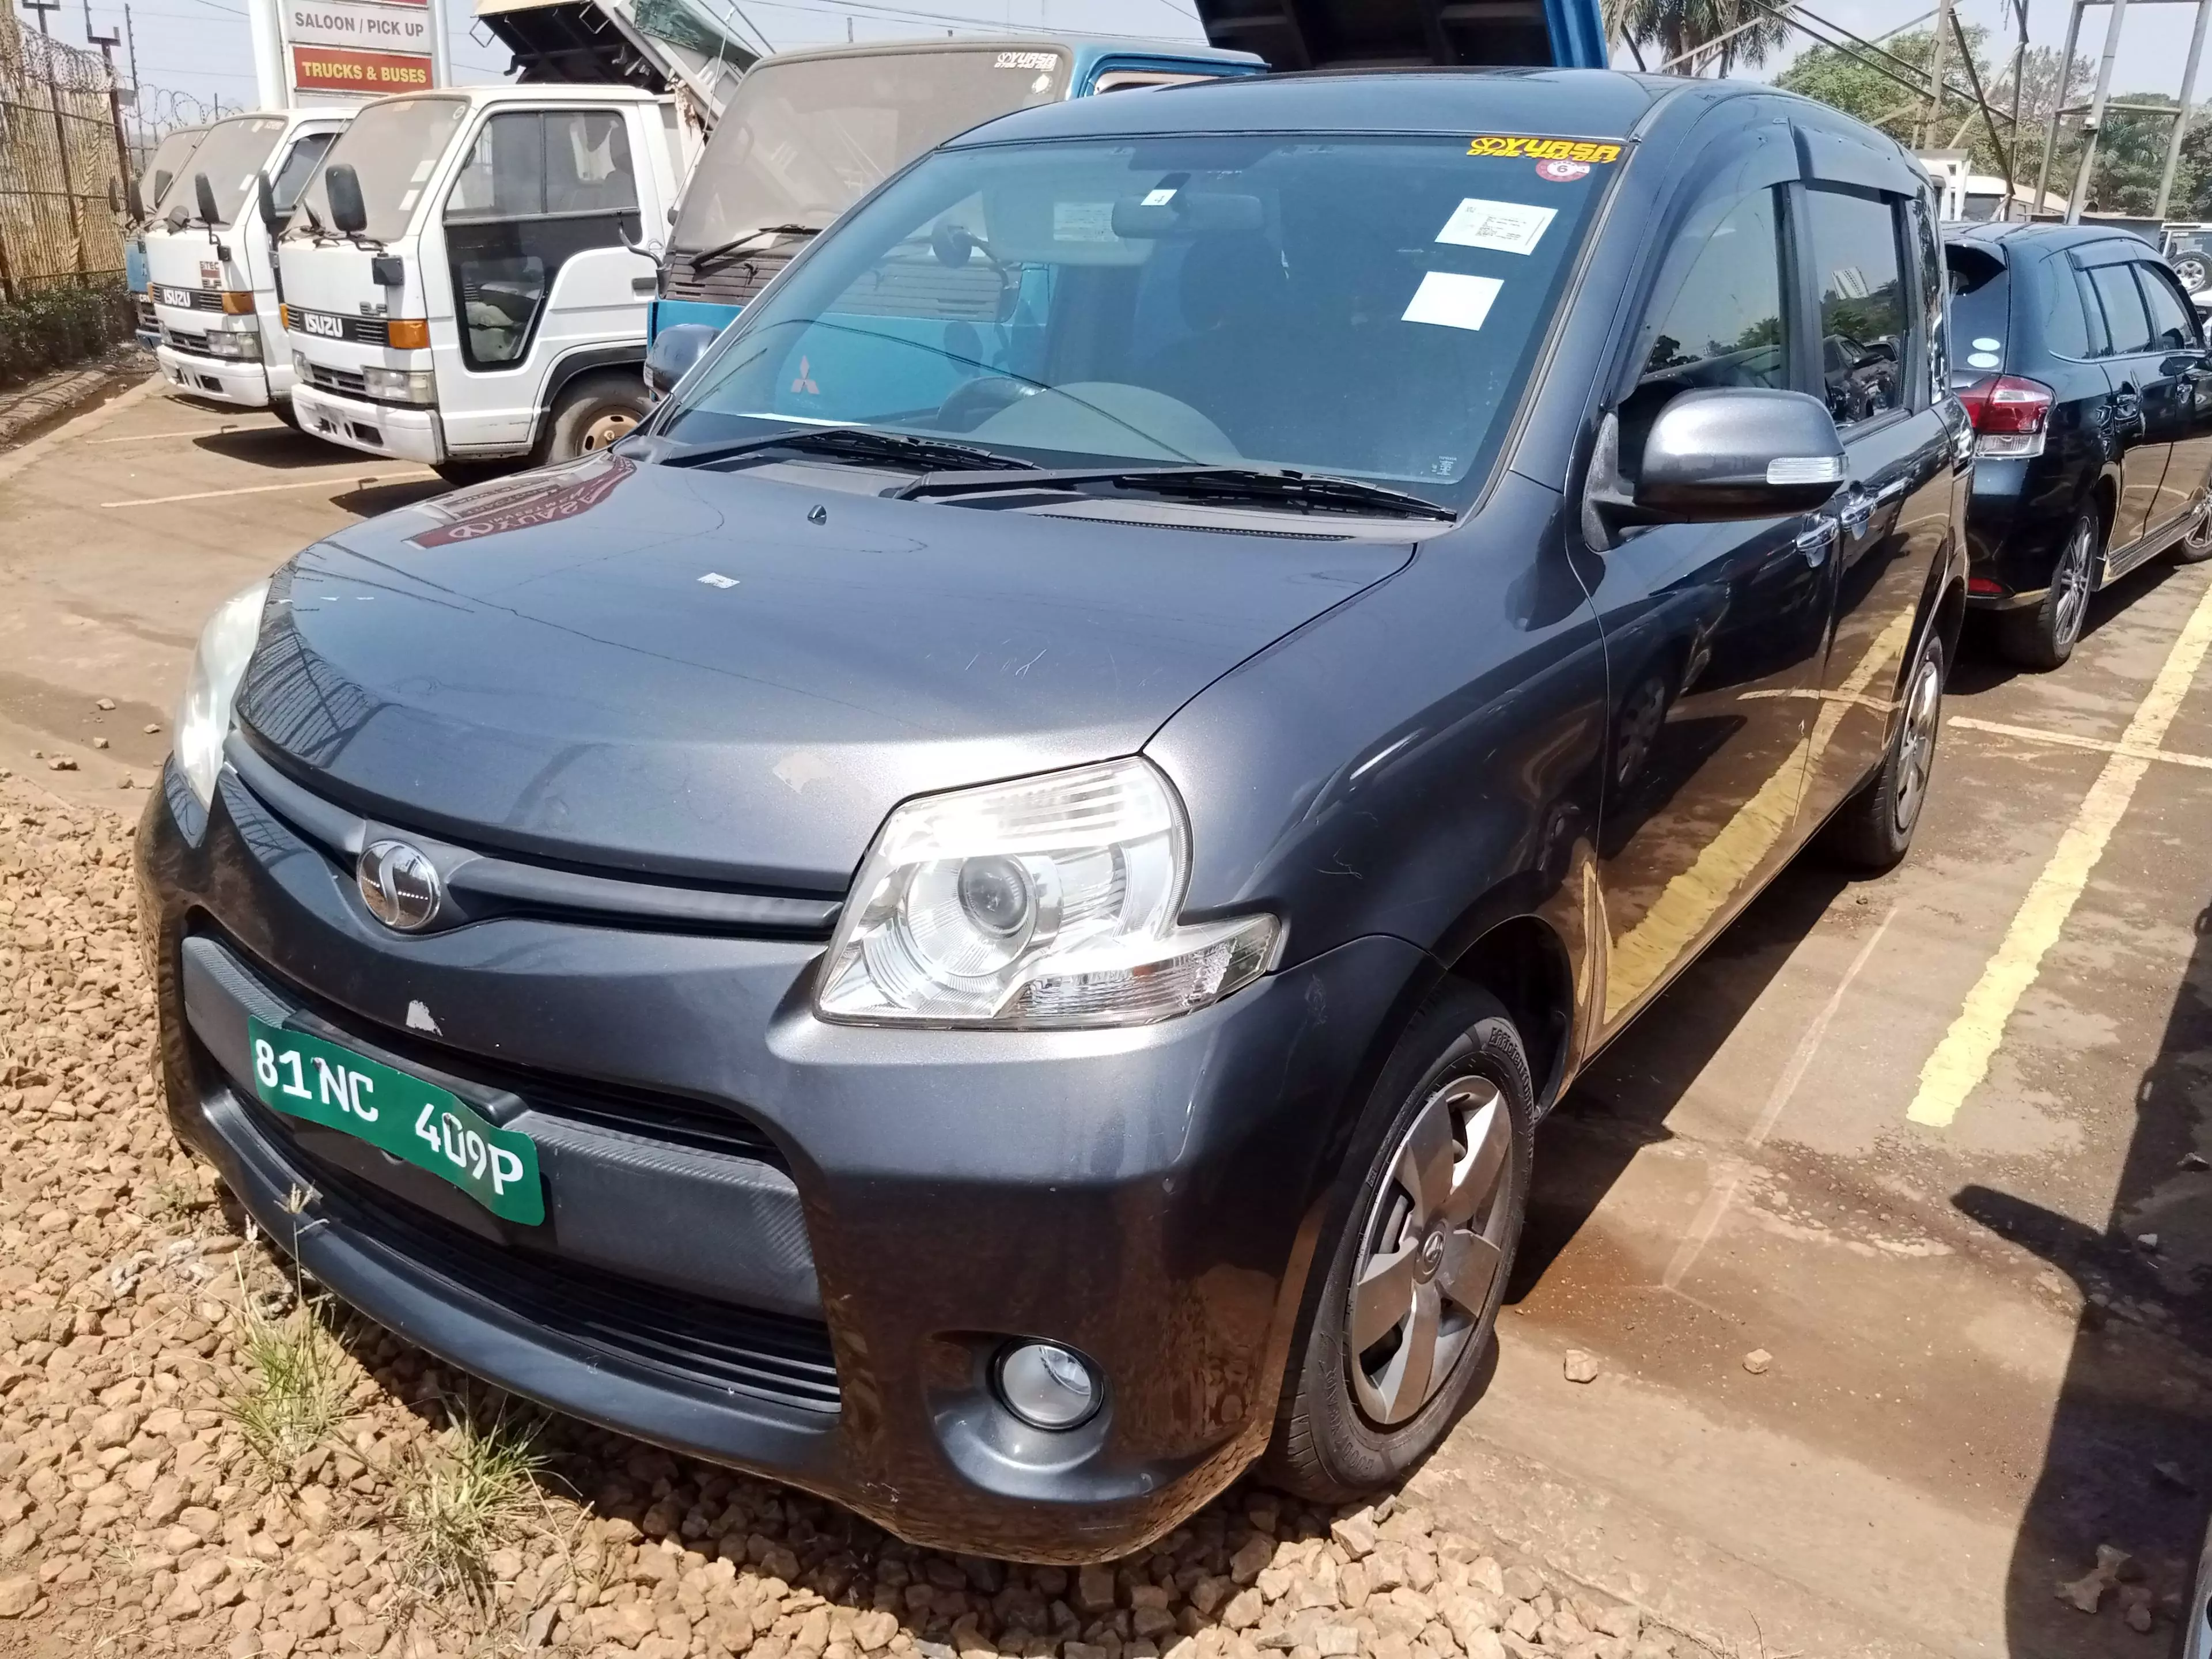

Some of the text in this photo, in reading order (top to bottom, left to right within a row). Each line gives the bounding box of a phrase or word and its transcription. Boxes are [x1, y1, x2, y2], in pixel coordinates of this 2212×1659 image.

[295, 12, 423, 37] SALOON / PICK UP
[1012, 52, 1058, 66] YUASA
[302, 61, 426, 84] TRUCKS & BUSES
[1505, 138, 1620, 158] YUASA
[1525, 151, 1569, 160] 440
[1572, 154, 1616, 164] 057
[1556, 165, 1568, 173] 6
[163, 289, 191, 307] ISUZU
[304, 313, 343, 338] ISUZU
[255, 1039, 524, 1196] 81NC 409P
